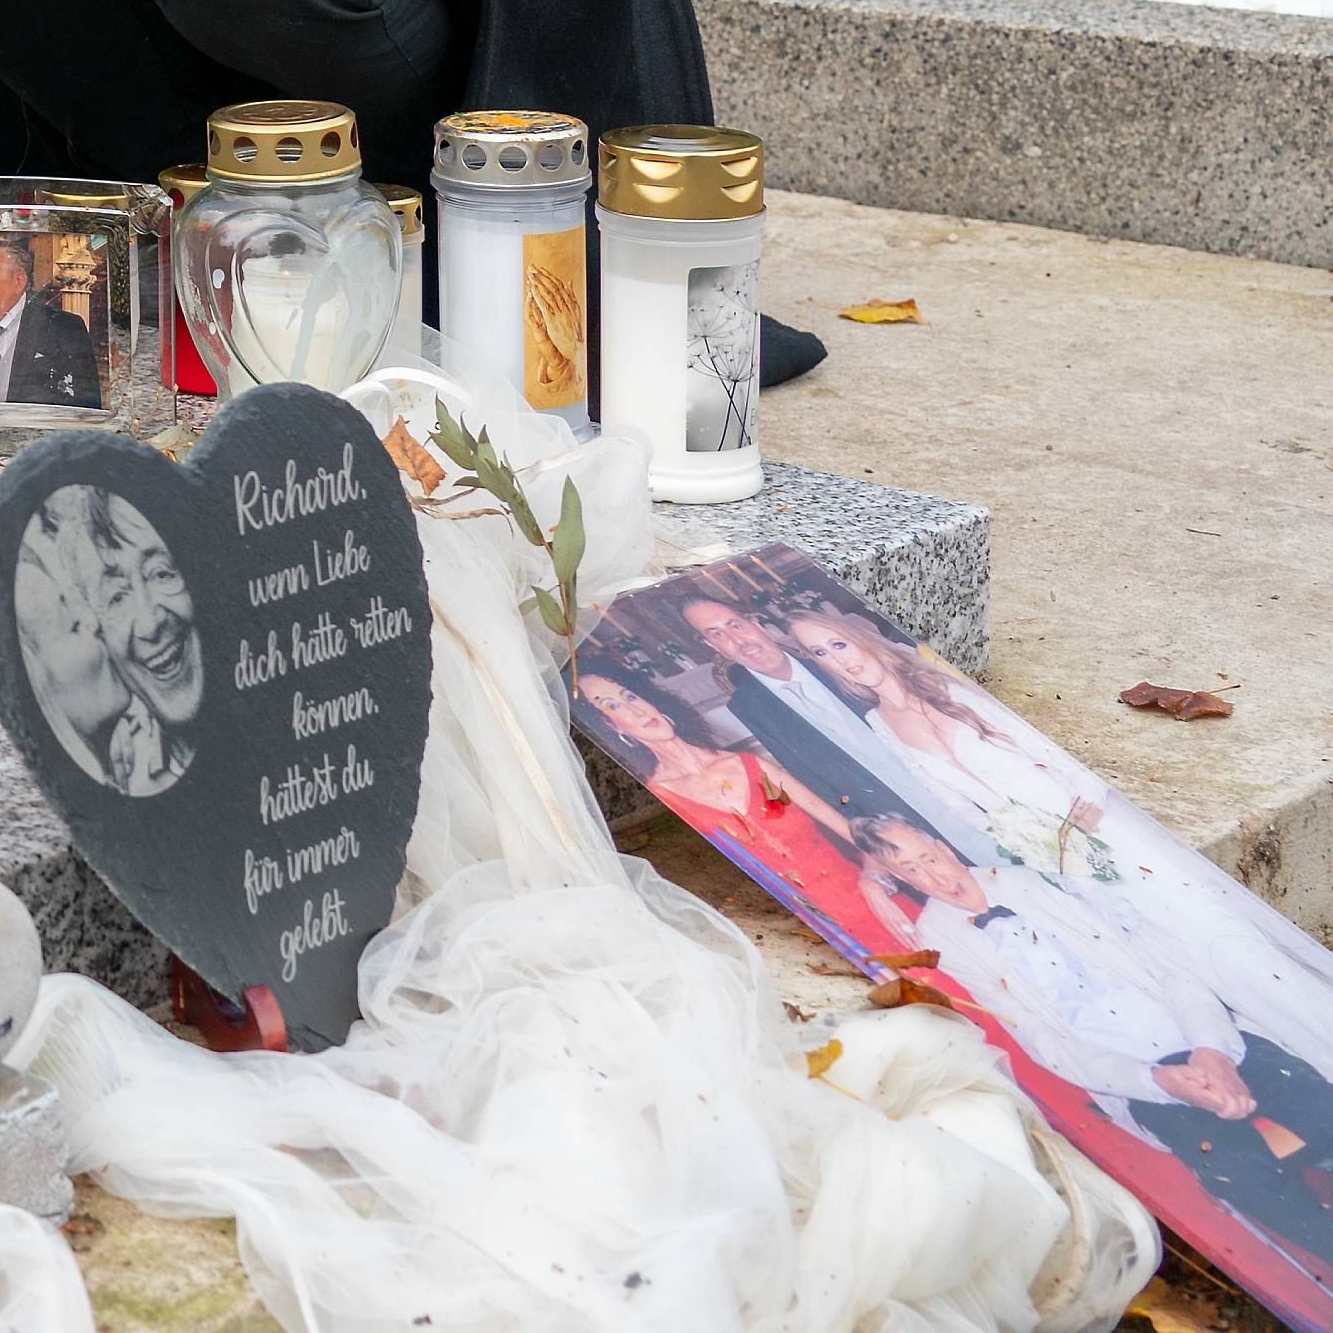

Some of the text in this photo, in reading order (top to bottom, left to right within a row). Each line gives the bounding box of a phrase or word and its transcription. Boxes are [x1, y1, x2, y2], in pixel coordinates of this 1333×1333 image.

[233, 442, 367, 536] Richard,
[248, 529, 371, 607] wenn Liebe
[234, 595, 412, 690] dich hätte retten
[259, 743, 374, 825] hättest du
[243, 826, 361, 915] für immer
[280, 888, 354, 983] gelebt.
